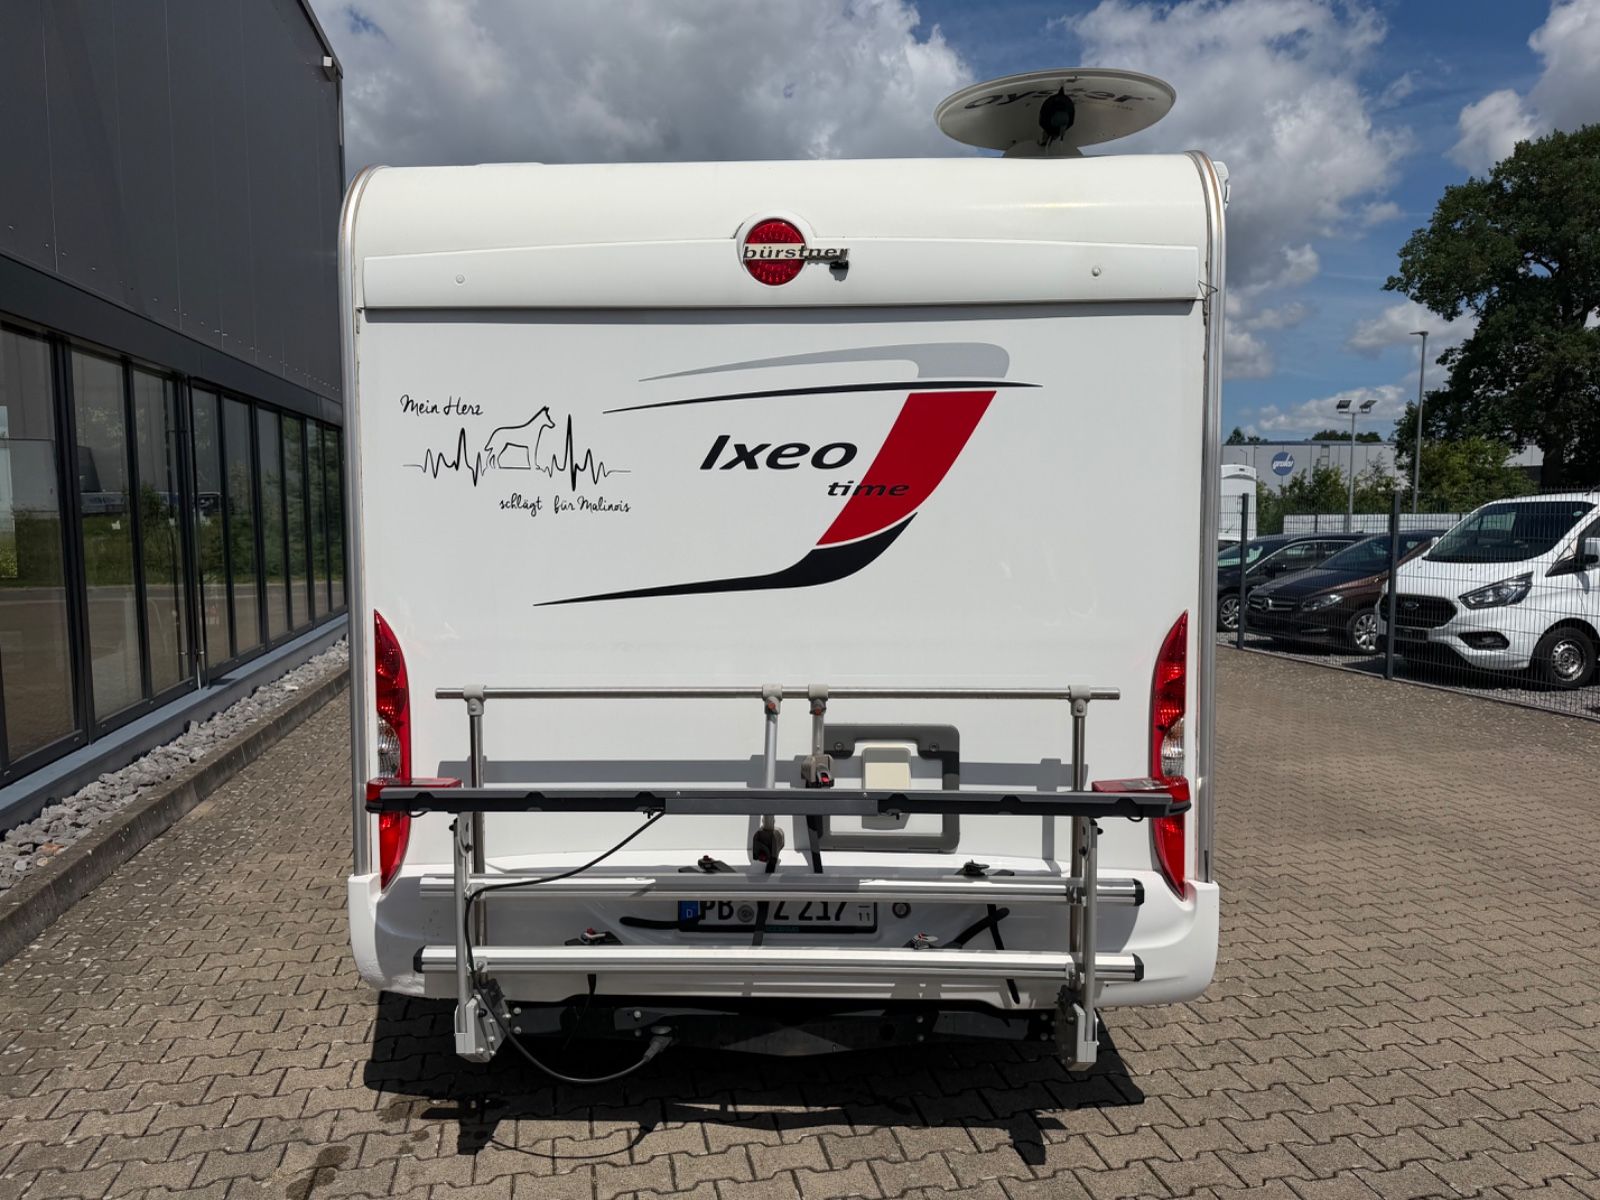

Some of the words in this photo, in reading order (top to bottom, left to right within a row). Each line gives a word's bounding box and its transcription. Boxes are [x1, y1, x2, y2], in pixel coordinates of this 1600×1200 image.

[743, 245, 850, 260] bürstner
[399, 394, 439, 416] Mein
[443, 395, 484, 416] Herz
[699, 434, 858, 470] Ixeo
[827, 480, 910, 497] time
[499, 493, 543, 517] schlägt
[553, 495, 576, 514] für
[577, 495, 632, 513] Malinois
[686, 908, 694, 918] D
[700, 901, 734, 921] PB
